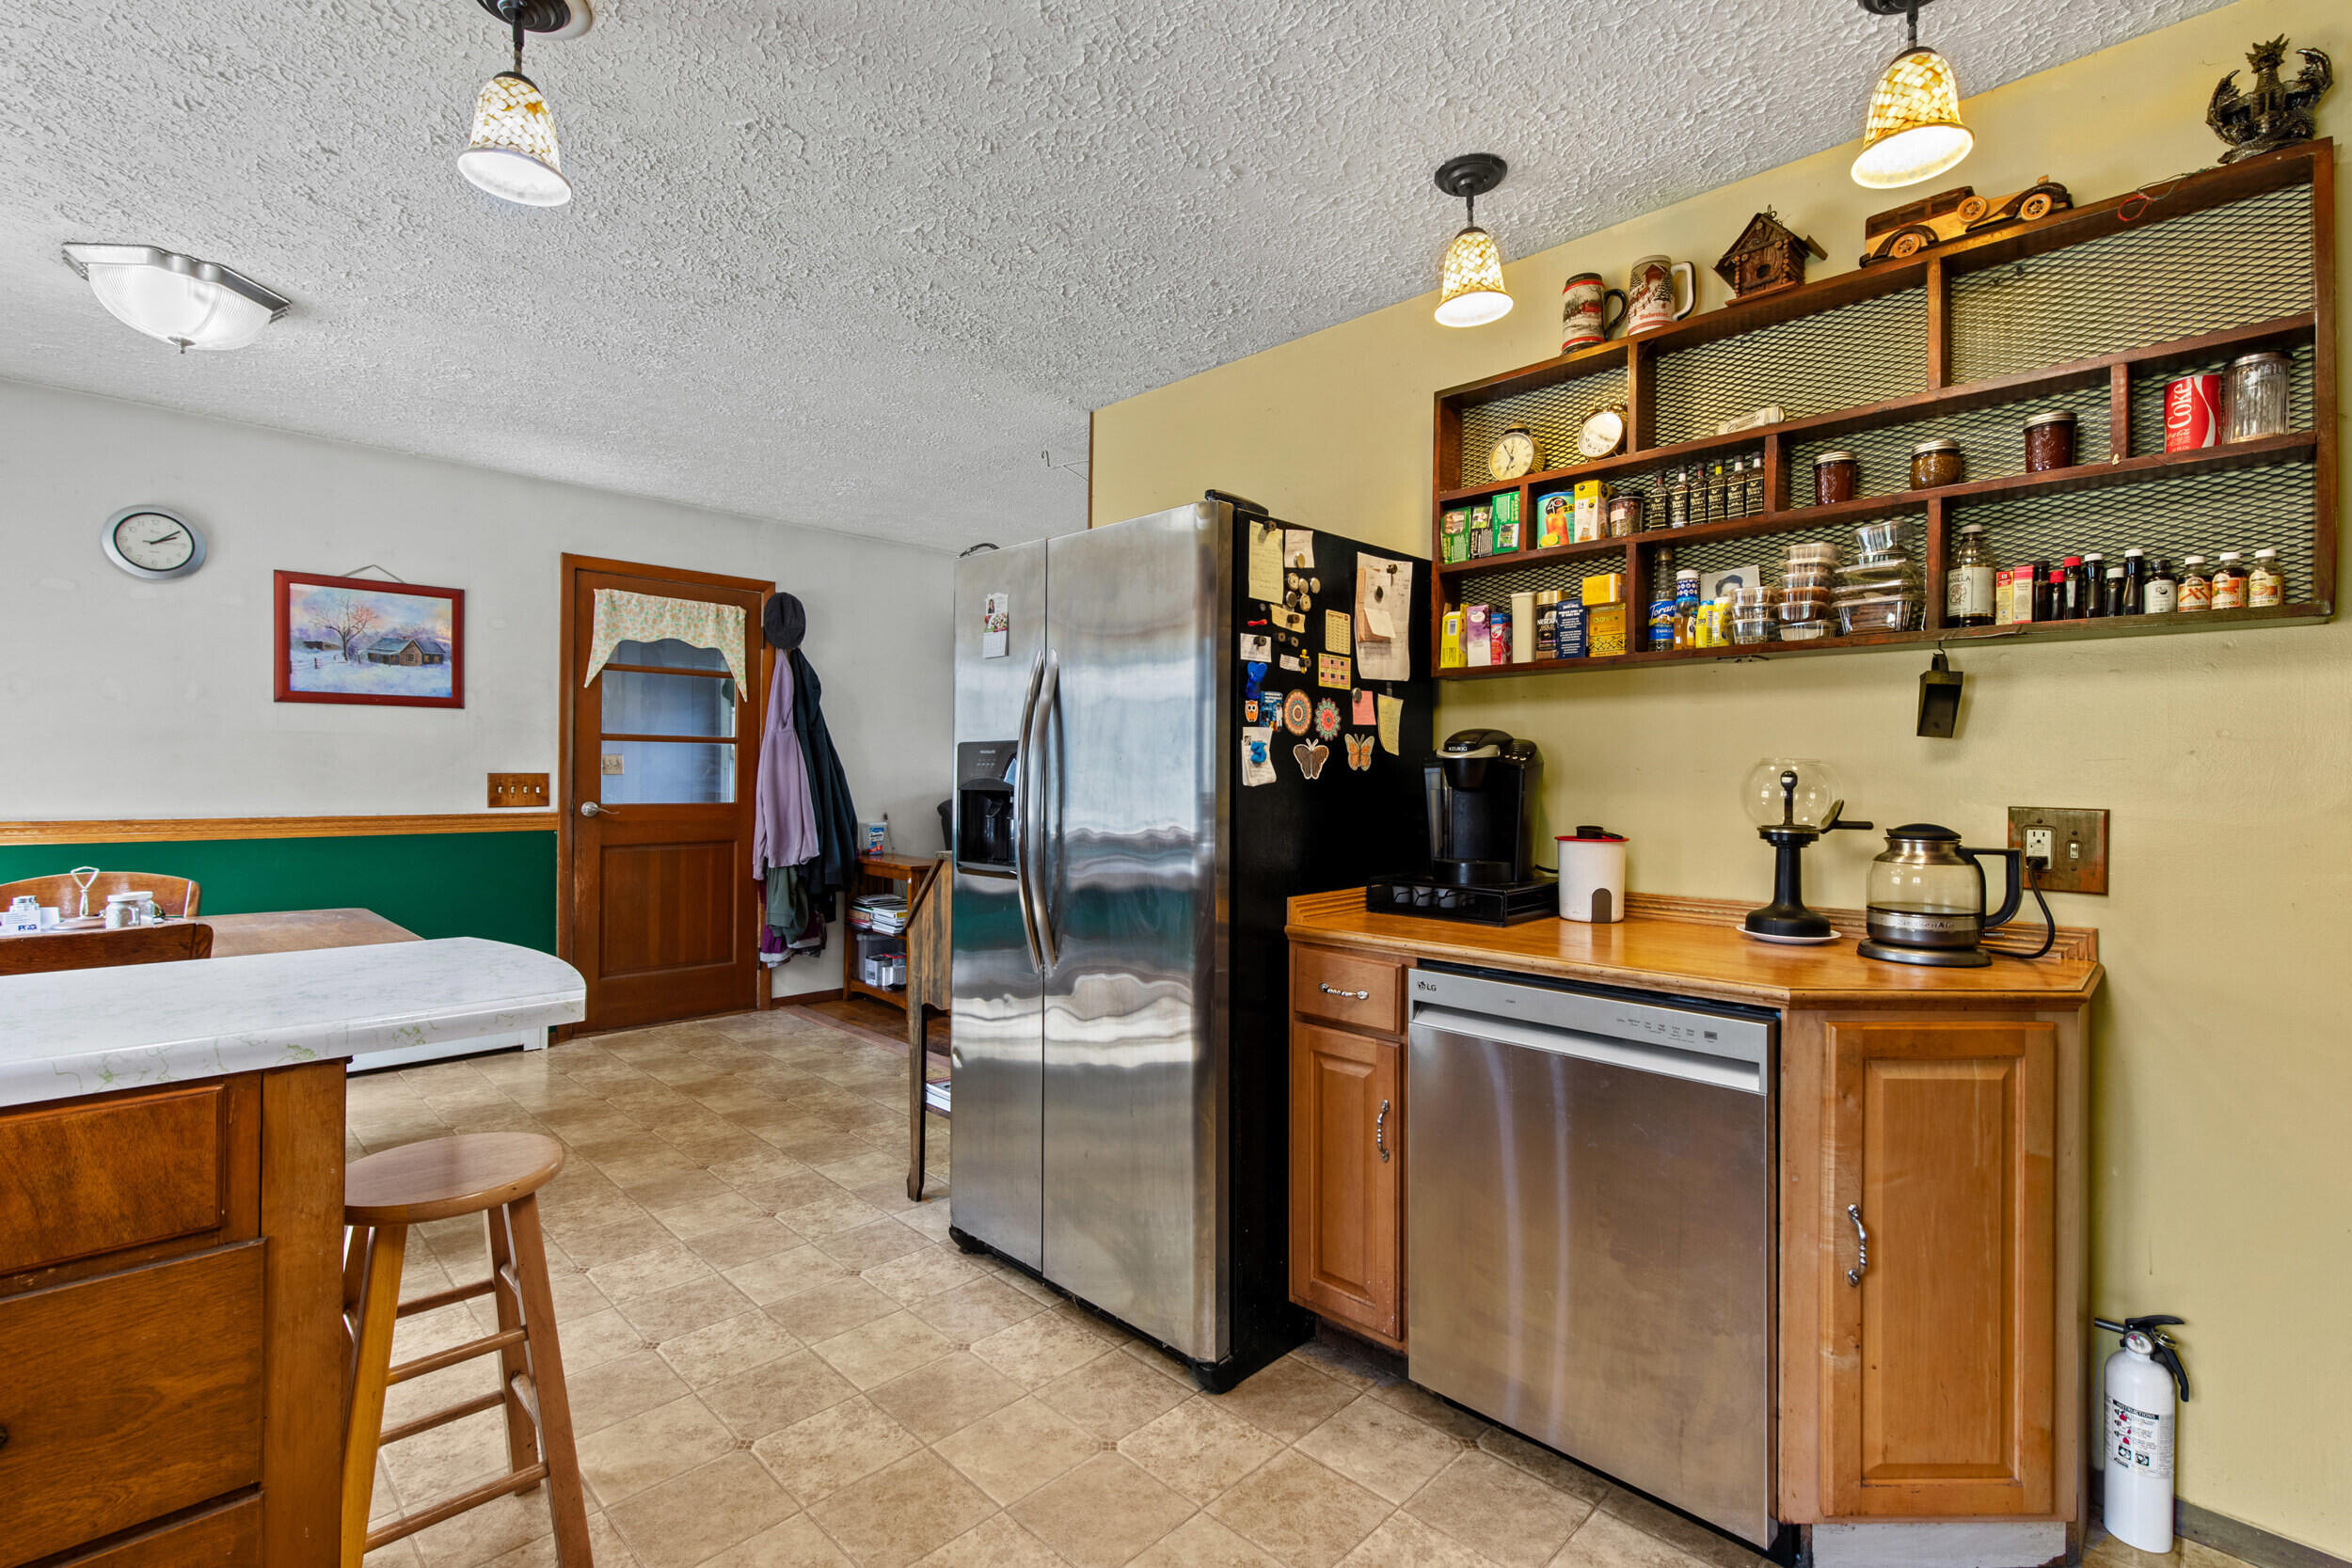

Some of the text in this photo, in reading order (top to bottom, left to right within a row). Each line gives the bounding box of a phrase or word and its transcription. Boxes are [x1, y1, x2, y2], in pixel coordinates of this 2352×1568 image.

[2168, 378, 2192, 429] Coke
[1649, 602, 1677, 621] Toran
[1897, 920, 1954, 928] KitenAid
